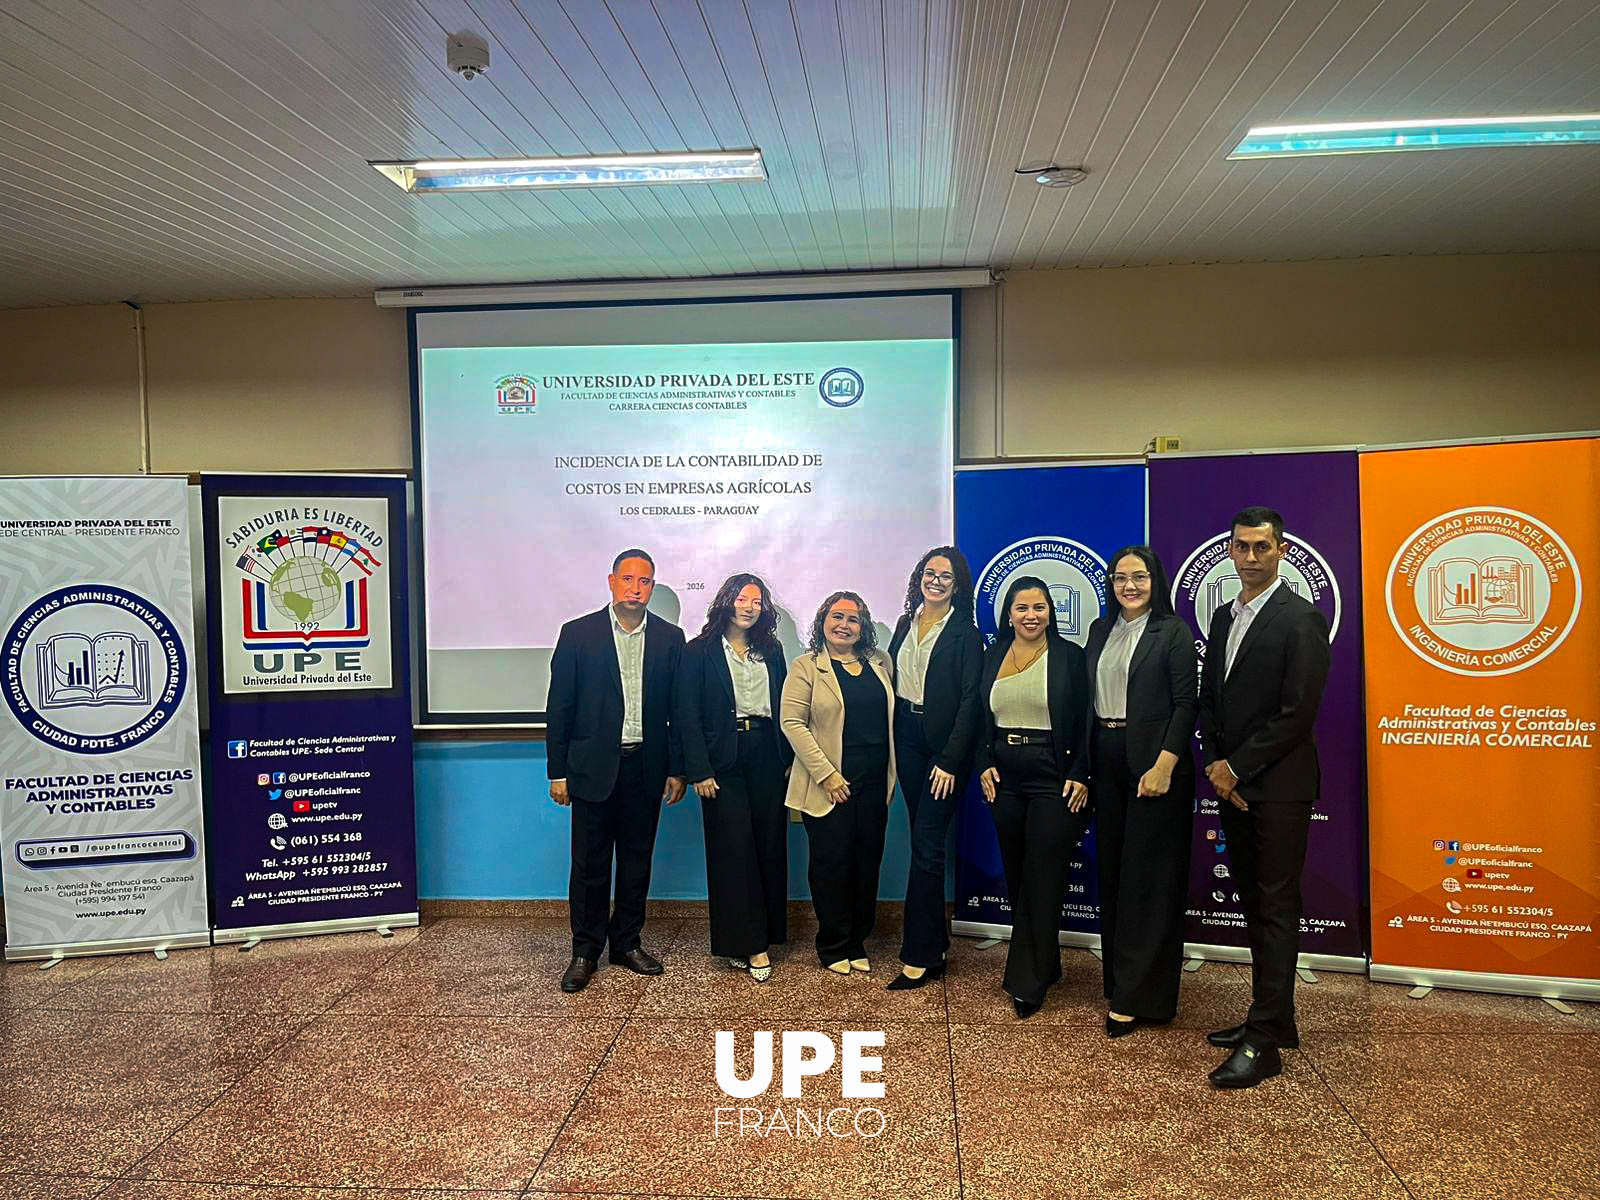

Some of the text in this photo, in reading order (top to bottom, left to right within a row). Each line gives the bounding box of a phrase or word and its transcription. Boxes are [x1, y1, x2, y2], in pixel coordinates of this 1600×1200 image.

[543, 372, 815, 389] UNIVERSIDAD PRIVADA DEL ESTE
[560, 390, 796, 400] FACULTAD DE CIENCIAS ADMINISTRATIVAS Y CONTABLES
[608, 401, 748, 411] CARRERA CIENCIAS CONTABLES
[554, 454, 823, 468] INCIDENCIA DE LA CONTABILIDAD DE
[565, 478, 812, 495] COSTOS EN EMPRESAS AGRÍCOLAS
[620, 505, 760, 516] LOS CEDRALES PARAGUAY
[0, 519, 172, 529] UNIVERSIDAD PRIVADA DEL ESTE
[225, 508, 384, 549] SABIDURIA ES LIBERTAD
[21, 527, 180, 537] CENTRAL PRESIDENTE FRANCO
[1398, 515, 1568, 575] UNIVERSIDAD PRIVADA DEL ESTE
[1406, 524, 1559, 588] FACULTAD DE CIENCIAS ADMINISTRATIVAS CONTABLES
[982, 543, 1094, 594] UNIVERSIDAD PRIVADA DEL
[1288, 546, 1309, 564] DEL
[1308, 562, 1328, 589] ESTE
[687, 582, 705, 590] 2026
[988, 576, 1003, 606] FACULTAD
[1001, 567, 1010, 578] DE
[1008, 554, 1034, 571] CIENCIAS
[1034, 552, 1086, 570] ADMINISTRATIVAS
[1087, 571, 1106, 606] CONTABLES
[1300, 566, 1321, 601] CONTABLES
[1188, 571, 1205, 602] FACULTAD
[294, 622, 320, 631] 1992
[1409, 624, 1558, 666] INGENIERÍA COMERCIAL
[8, 591, 180, 714] FACULTAD DE CIENCIAS ADMINISTRATIVAS Y CONTABLES
[253, 651, 362, 674] UPE
[243, 672, 372, 686] Universidad Privada del Este
[1404, 704, 1568, 718] Facultad de Ciencias
[32, 710, 166, 749] CIUDAD PDTE. FRANCO
[1378, 716, 1597, 734] Administrativas y Contables
[249, 734, 397, 748] Facultad de Ciencias Administrativas y
[1381, 730, 1593, 748] INGENIERÍA COMERCIAL
[249, 748, 290, 758] Contables
[314, 746, 334, 754] Sede
[335, 745, 366, 754] Central
[5, 770, 194, 790] FACULTAD DE CIENCIAS
[288, 770, 371, 783] @UPEoficialfranco
[26, 784, 174, 803] ADMINISTRATIVAS
[284, 787, 362, 800] @UPEoficialfranc
[46, 798, 156, 814] Y CONTABLES
[312, 802, 338, 812] upetv
[291, 812, 363, 824] www.upe.edu.py
[290, 832, 362, 848] (061) 554 368
[1462, 842, 1543, 854] @UPEoficialfranco
[262, 852, 372, 868] Tel. +595 61 552304/5
[1458, 856, 1534, 868] @UPEoficialfranc
[245, 862, 388, 882] WhatsApp +595 993 282857
[1484, 870, 1510, 880] upetv
[56, 882, 88, 891] Avenida
[58, 890, 87, 898] Ciudad
[89, 886, 132, 896] Presidente
[278, 889, 310, 897] AVENIDA
[352, 884, 368, 892] ESQ.
[1068, 884, 1084, 893] 368
[1464, 881, 1534, 894] www.upe.edu.py
[268, 898, 296, 906] CIUDAD
[298, 894, 340, 903] PRESIDENTE
[340, 892, 370, 900] FRANCO
[75, 908, 146, 918] www.upe.edu.py
[1067, 911, 1096, 919] FRANCO
[1212, 912, 1245, 920] AVENIDA
[1463, 904, 1554, 917] +595 61 552304/5
[1202, 918, 1230, 926] CIUDAD
[1442, 918, 1478, 926] AVENIDA
[1531, 922, 1549, 930] ESQ.
[1430, 925, 1568, 940] CIUDAD PRESIDENTE FRANCO PY
